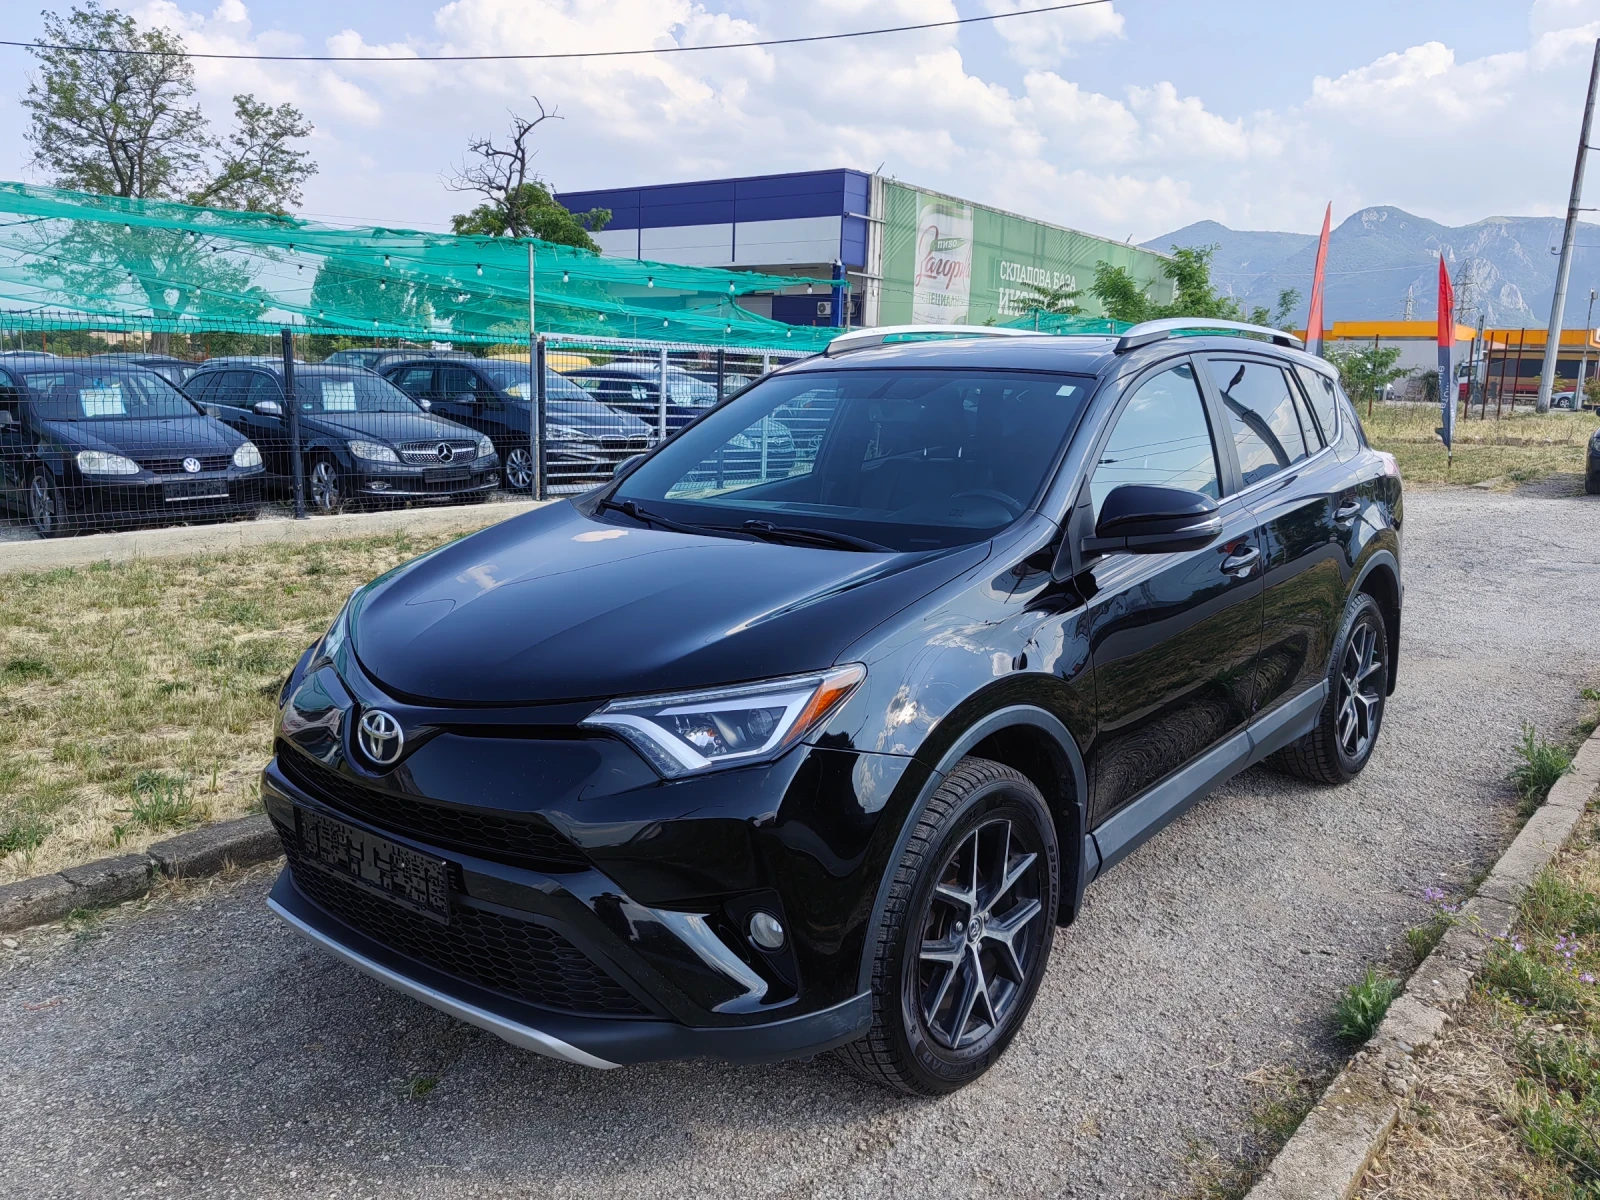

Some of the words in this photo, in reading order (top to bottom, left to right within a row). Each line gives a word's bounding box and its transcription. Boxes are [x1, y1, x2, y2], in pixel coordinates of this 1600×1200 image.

[937, 240, 957, 249] ПИВО
[1000, 260, 1051, 289] СКЛАДОВА
[1053, 271, 1076, 292] БАЗА
